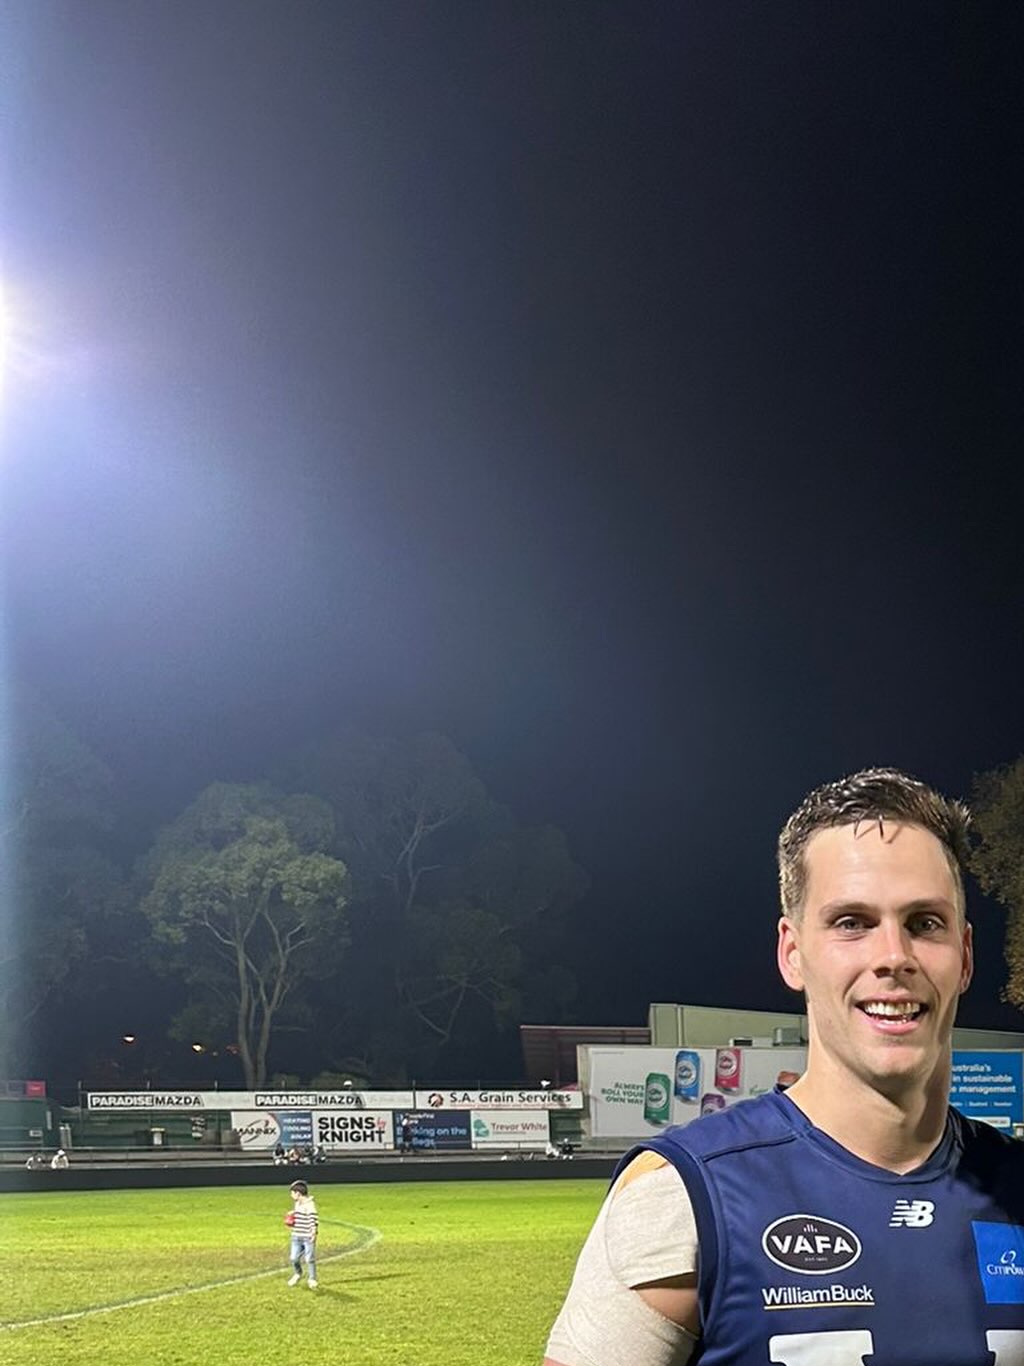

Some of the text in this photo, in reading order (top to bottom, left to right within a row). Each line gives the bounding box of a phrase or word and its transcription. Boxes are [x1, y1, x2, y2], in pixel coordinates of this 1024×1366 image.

[952, 1064, 991, 1072] ustralia's
[963, 1074, 1013, 1083] sustainable
[959, 1085, 1016, 1095] management
[92, 1095, 201, 1107] PARADISE MAZDA
[256, 1095, 316, 1106] PARADISE
[318, 1095, 363, 1105] MAZDA
[450, 1091, 572, 1103] S.A. Grain Services
[318, 1117, 376, 1130] SIGNS
[491, 1122, 547, 1131] Trevor White
[319, 1130, 385, 1143] KNIGHT
[436, 1128, 449, 1136] on
[451, 1127, 467, 1136] the
[770, 1235, 854, 1254] VAFA
